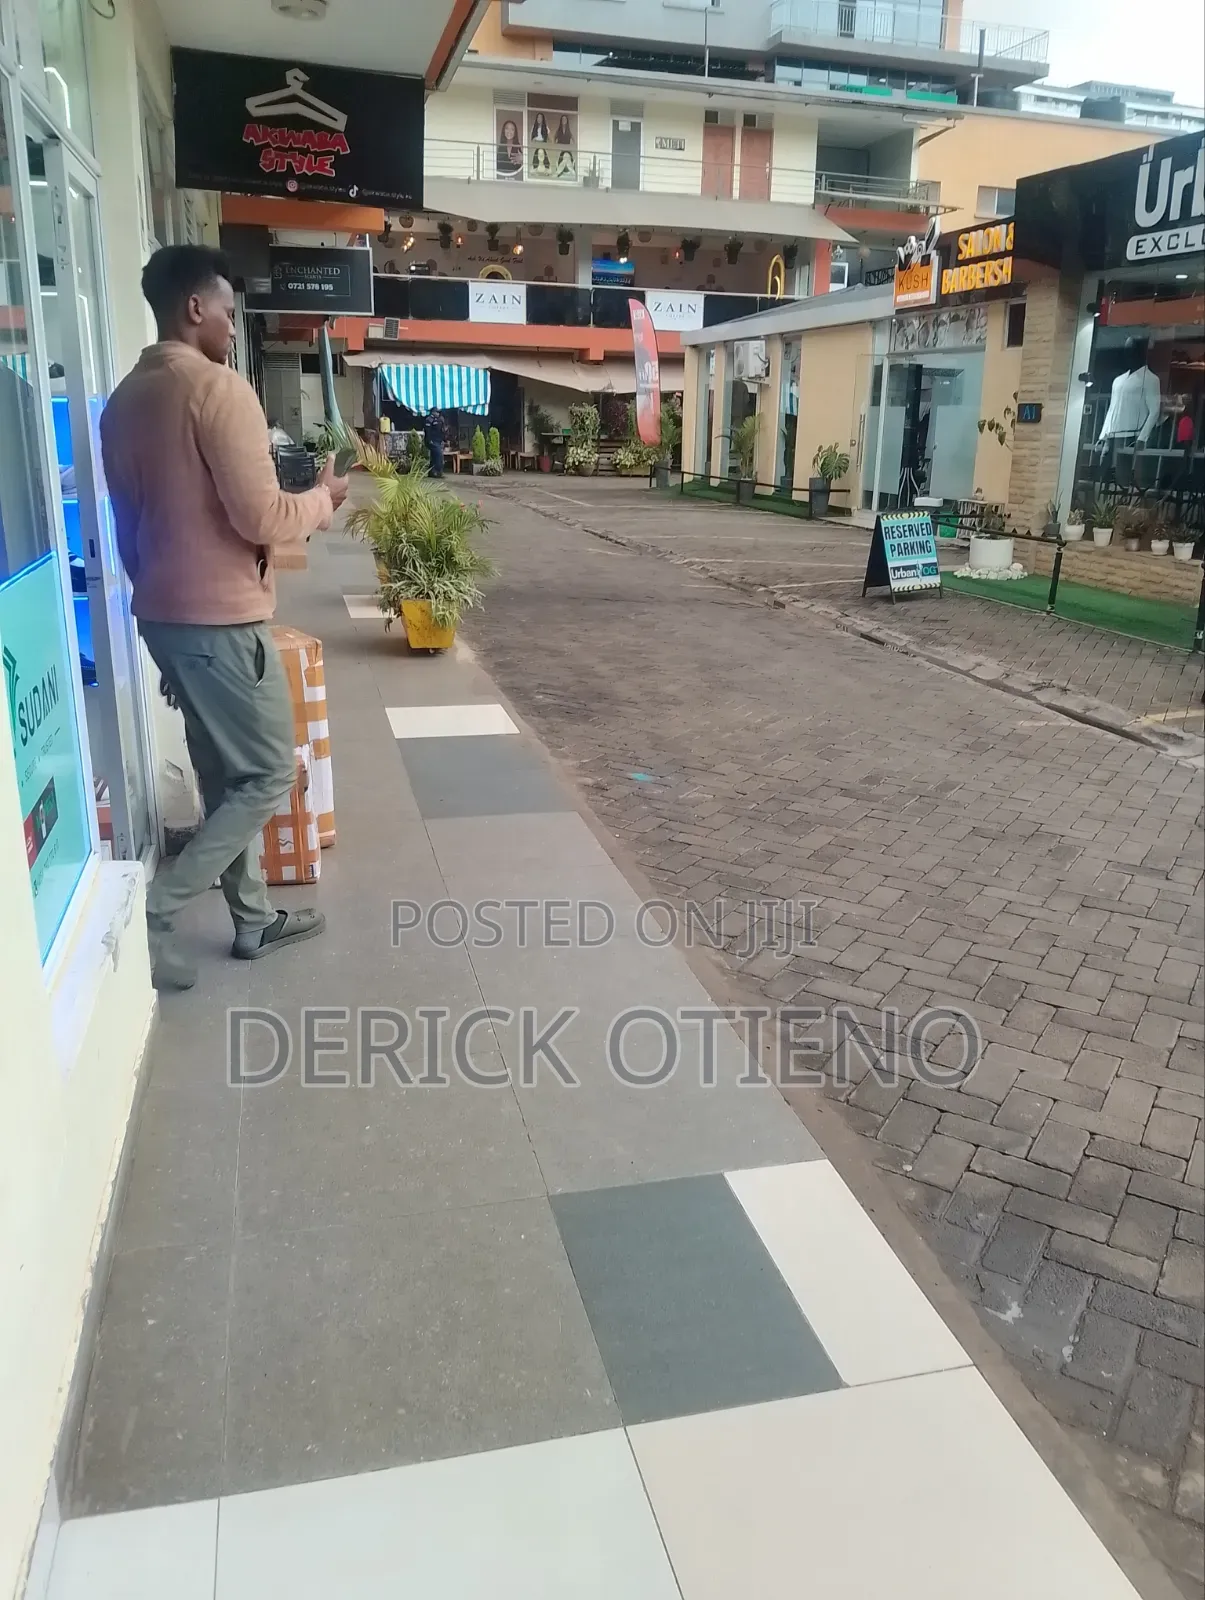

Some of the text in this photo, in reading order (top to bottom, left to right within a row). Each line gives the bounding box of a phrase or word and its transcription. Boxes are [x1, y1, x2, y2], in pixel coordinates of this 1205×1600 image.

[242, 123, 351, 155] AKWABA
[258, 148, 336, 178] STYLE
[957, 223, 1007, 261] SALON
[285, 265, 341, 276] ENCHANTED
[287, 282, 305, 291] 0721
[321, 283, 334, 291] 195
[898, 271, 930, 292] KUSH
[475, 292, 522, 306] ZAIN
[653, 301, 697, 314] ZAIN
[883, 522, 932, 540] RESERVED
[889, 539, 932, 557] PARKING
[891, 567, 917, 580] Urban
[18, 663, 60, 748] SUDANI
